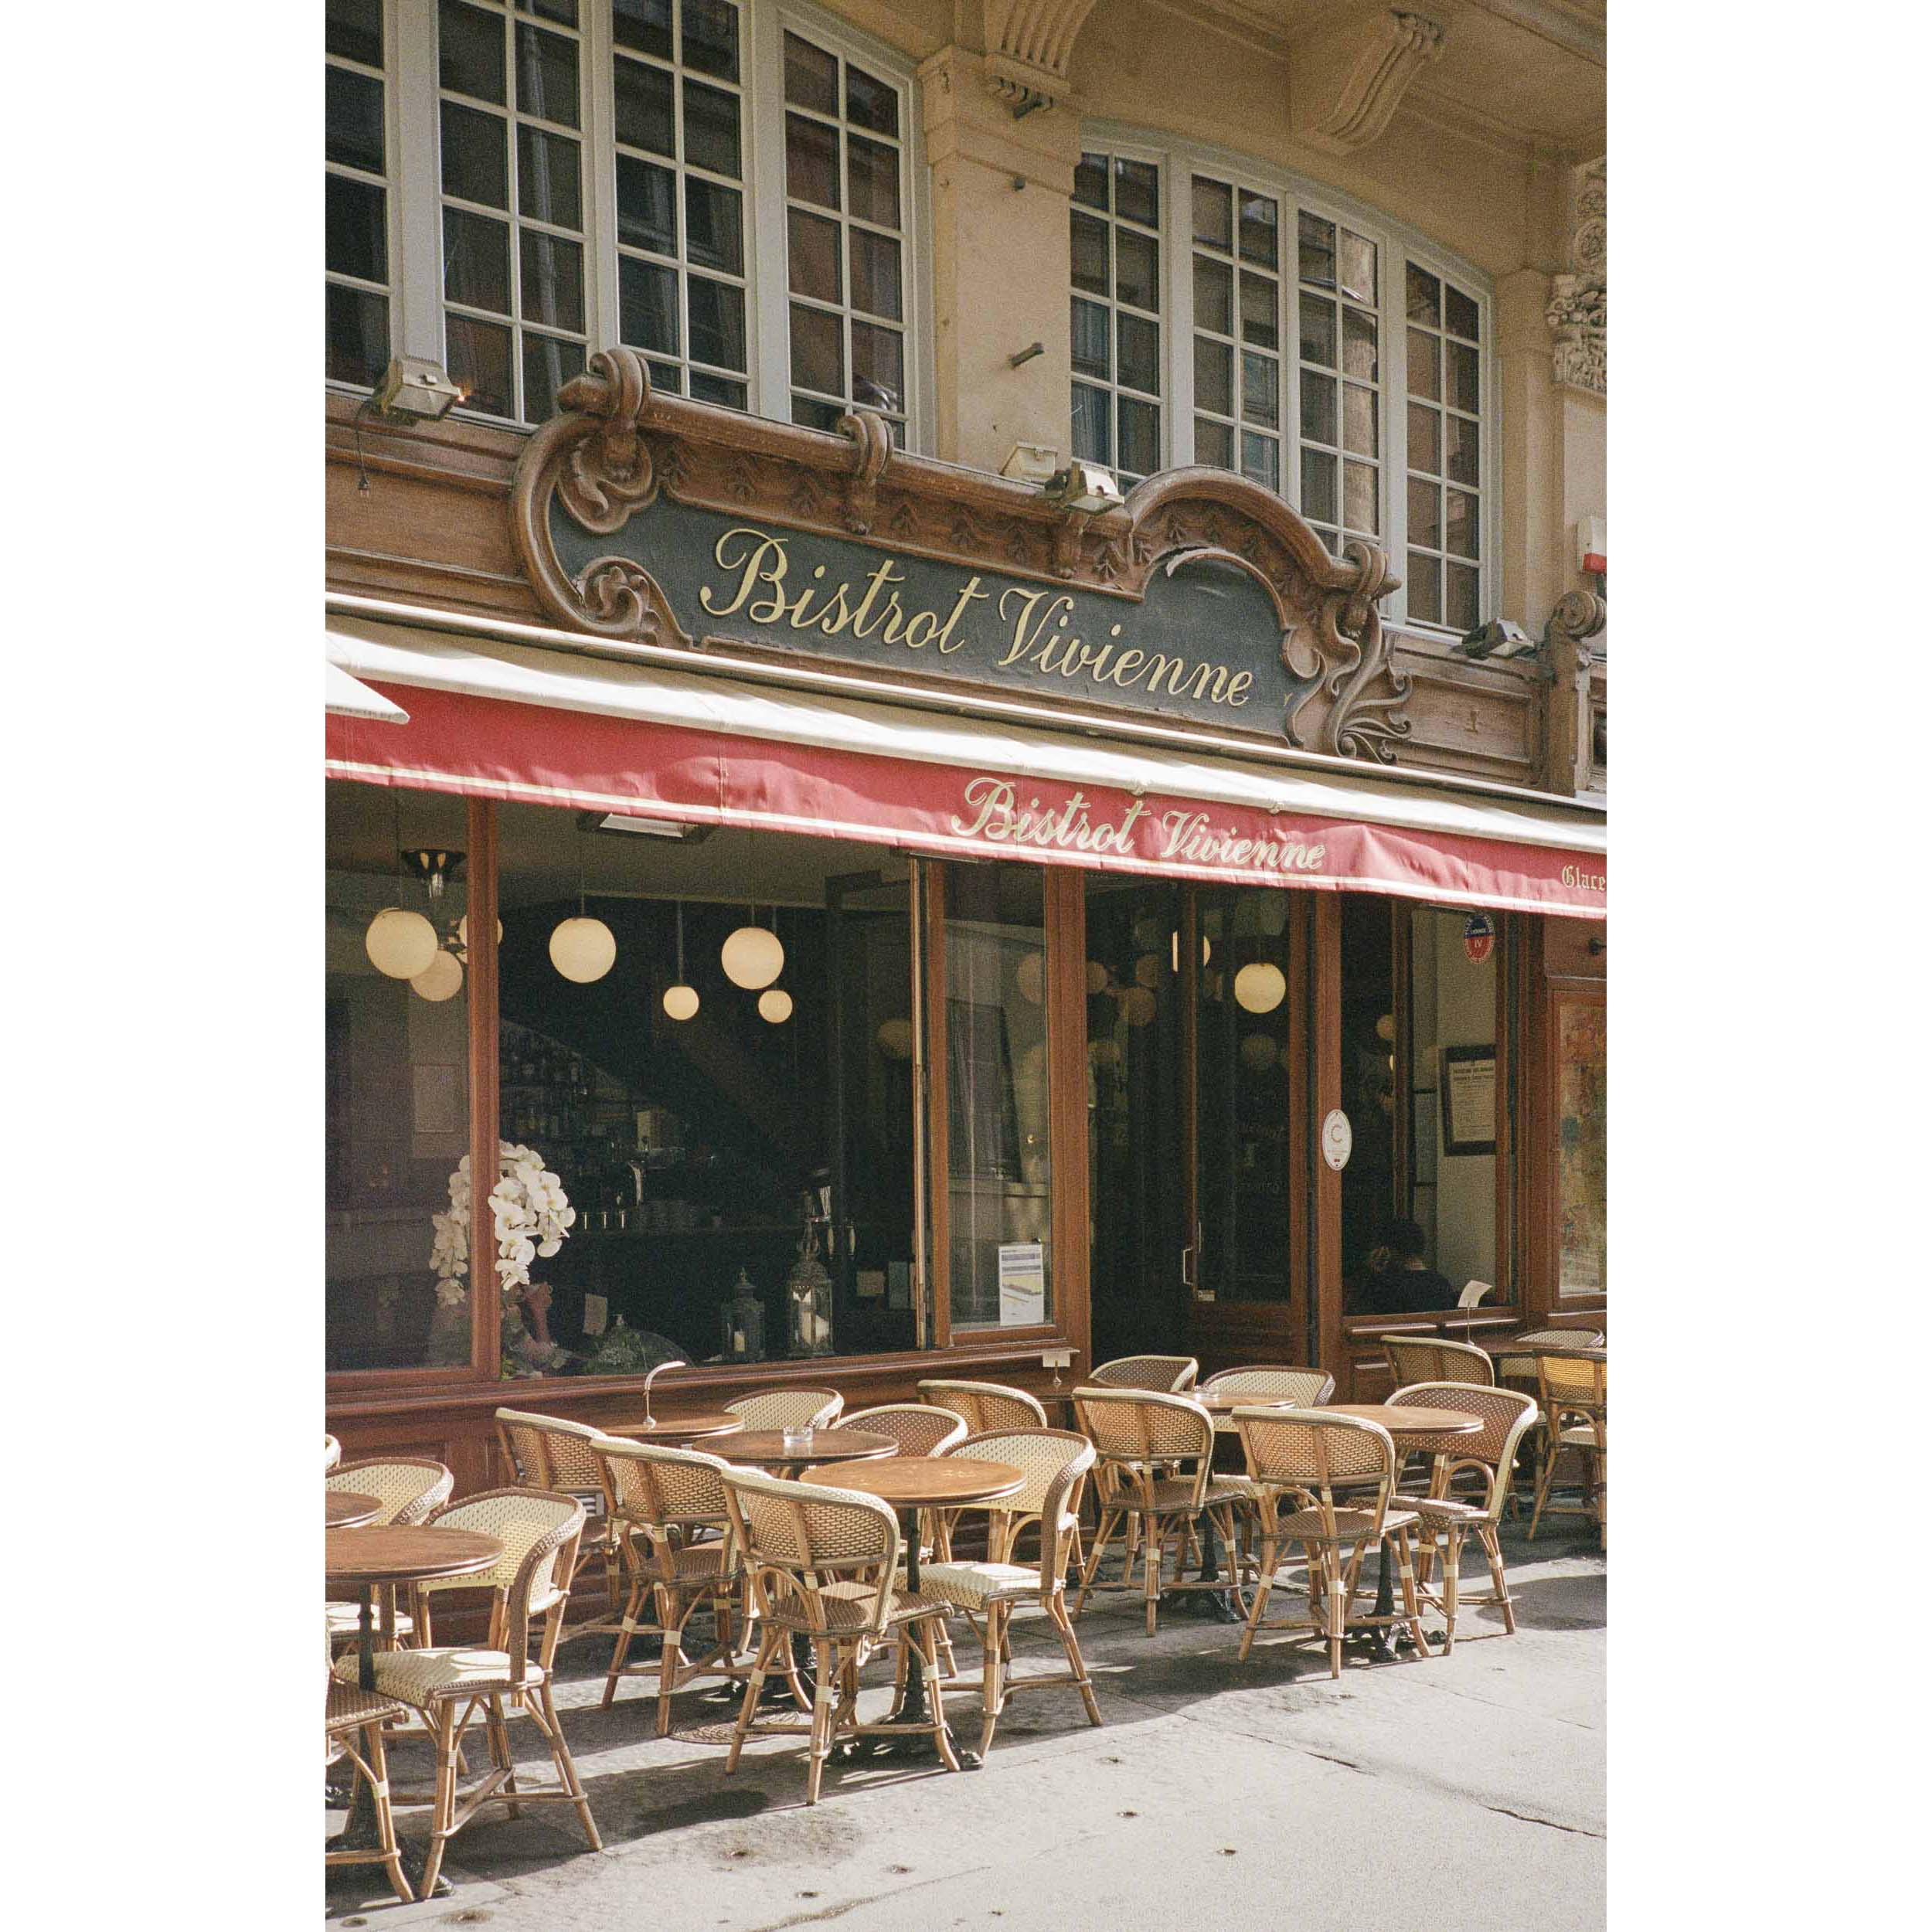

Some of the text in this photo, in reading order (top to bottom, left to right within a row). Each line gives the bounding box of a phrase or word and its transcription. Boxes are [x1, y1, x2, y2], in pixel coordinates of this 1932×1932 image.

[699, 528, 1254, 707] Bistrot Vivienne
[951, 777, 1326, 870] Bistrot Vivienne
